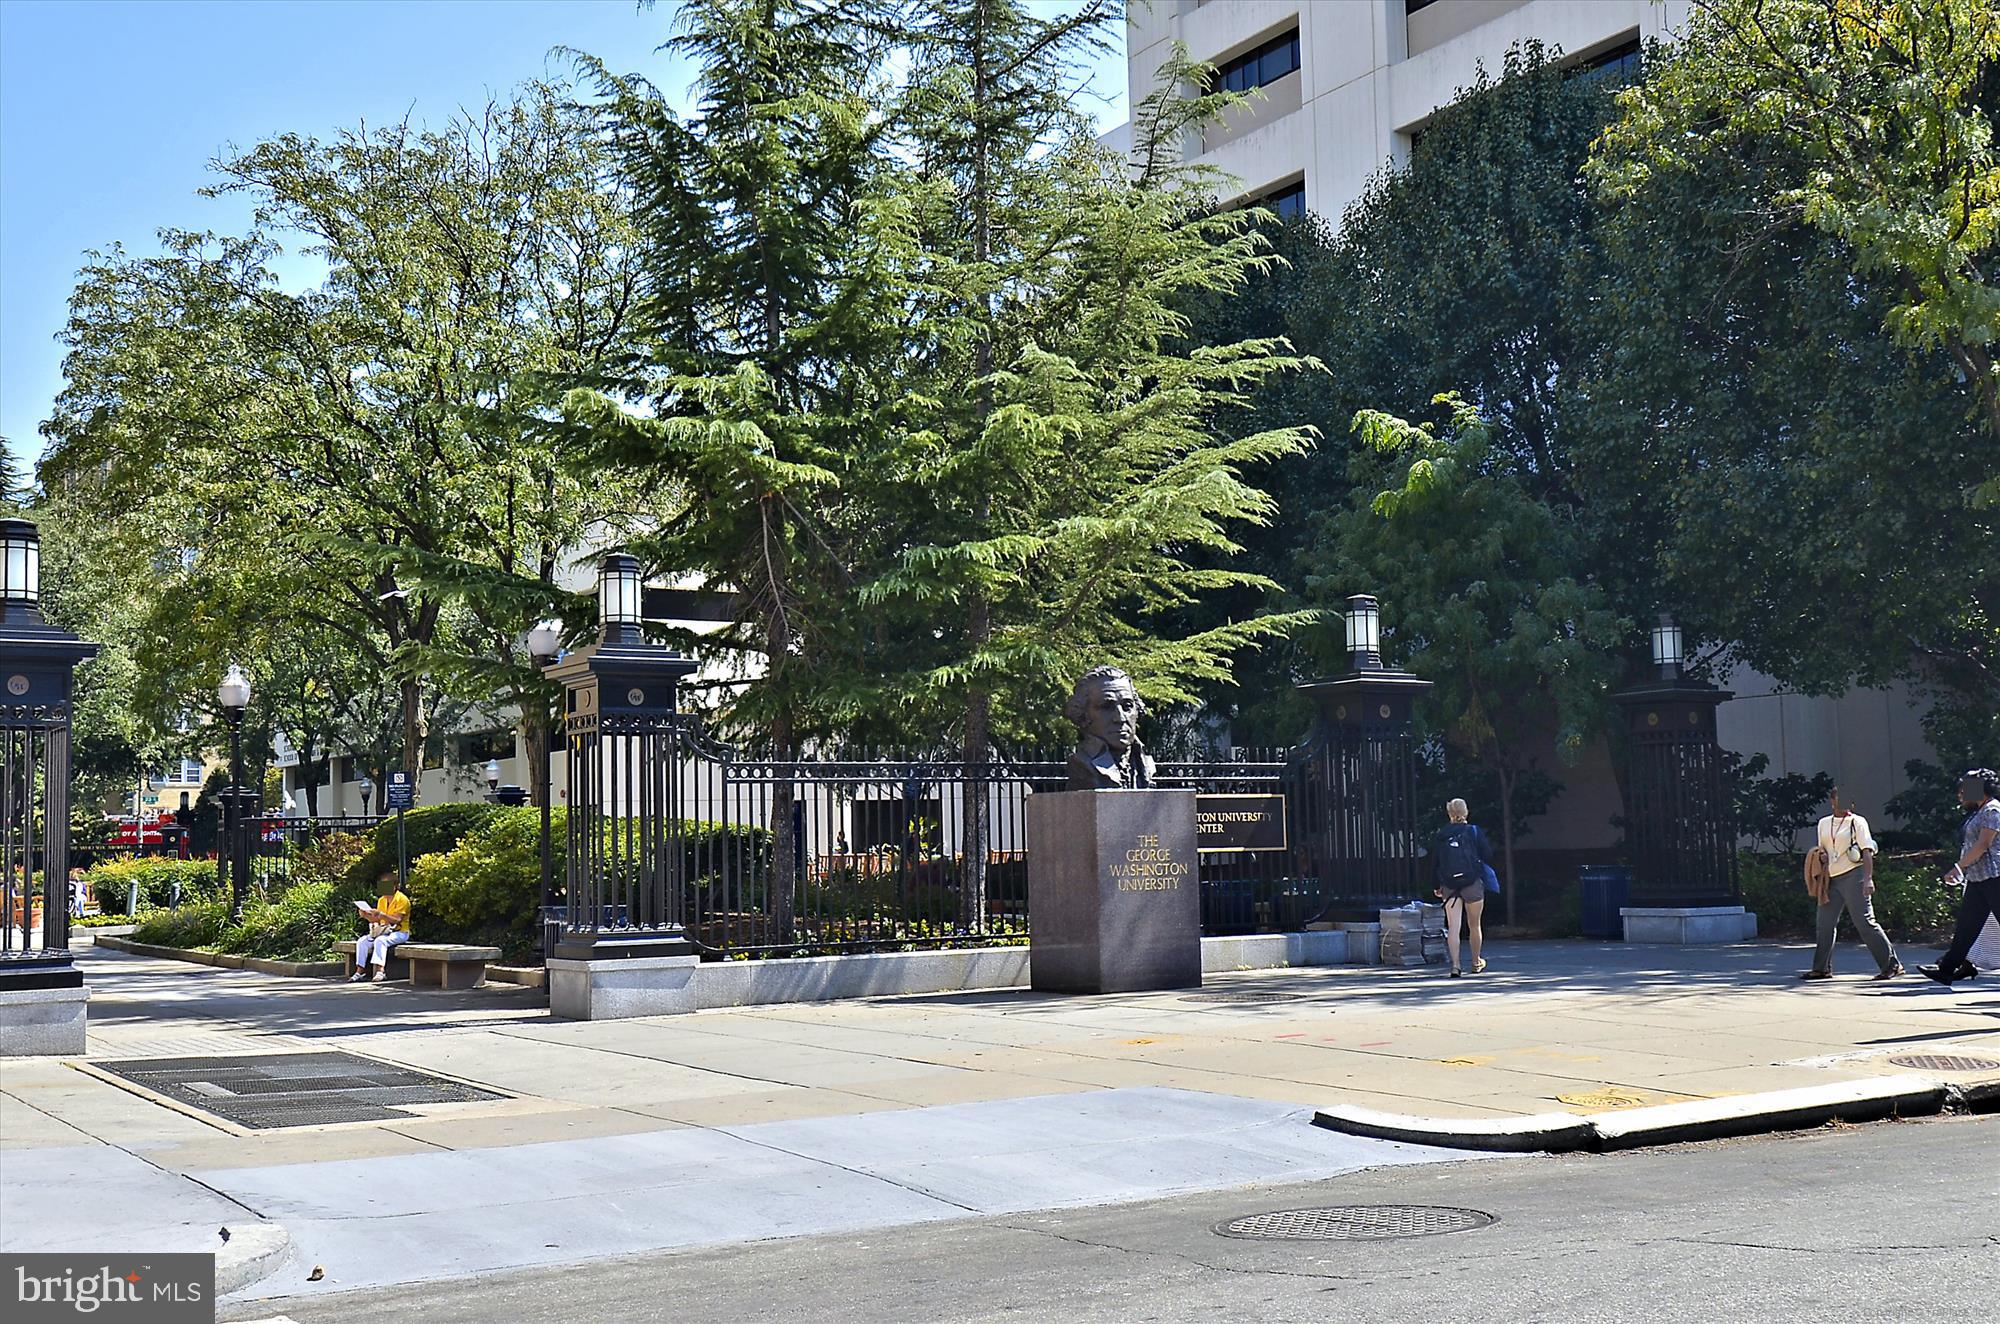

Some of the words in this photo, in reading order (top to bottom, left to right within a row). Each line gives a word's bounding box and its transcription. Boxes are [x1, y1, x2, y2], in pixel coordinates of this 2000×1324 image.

[1217, 812, 1273, 822] UNIVERSITY
[1196, 823, 1225, 834] ENTER
[1137, 834, 1159, 847] THE
[1126, 848, 1171, 862] GEORGE
[1109, 862, 1188, 877] WASHINGTON
[1118, 877, 1180, 891] UNIVERSITY
